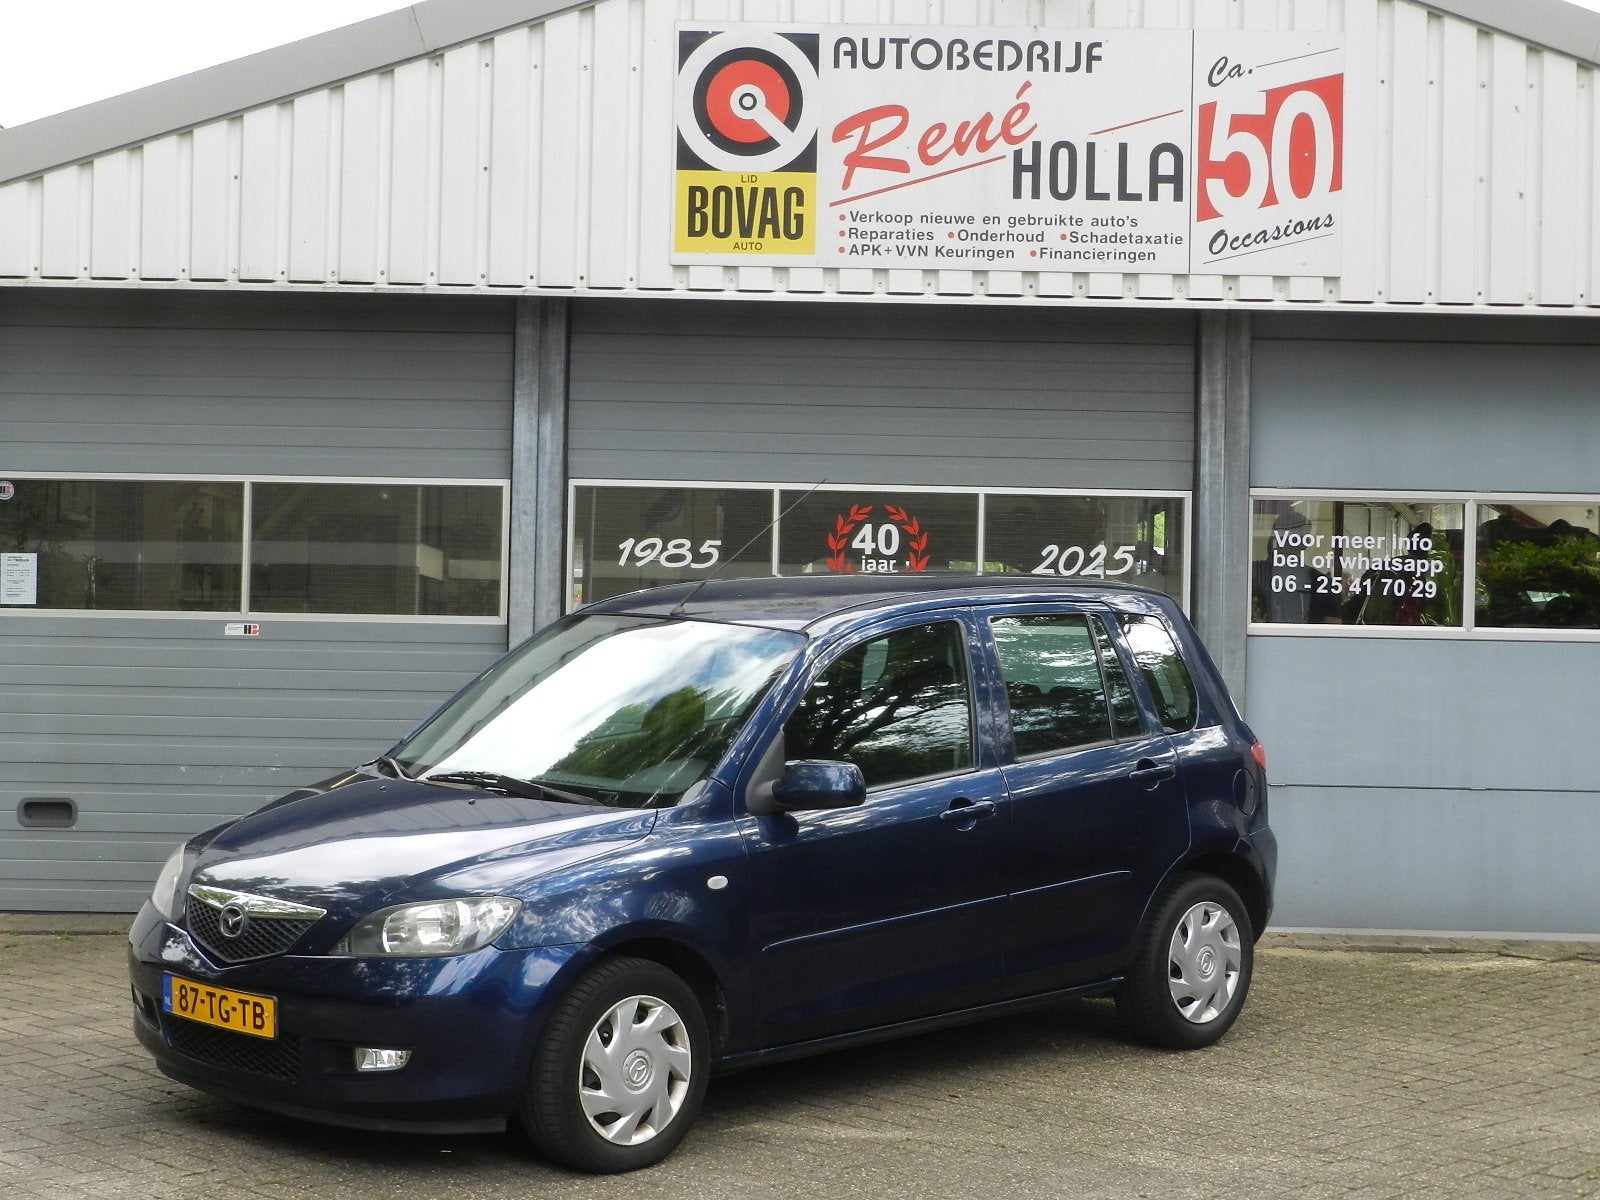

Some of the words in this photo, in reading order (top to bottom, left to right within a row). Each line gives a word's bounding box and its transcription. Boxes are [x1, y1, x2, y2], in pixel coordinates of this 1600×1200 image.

[833, 37, 1102, 73] AUTOBEDRIJF
[1207, 56, 1253, 87] Ca.
[832, 80, 1037, 190] René
[1012, 140, 1184, 202] HOLLA
[1205, 90, 1334, 220] 50
[741, 175, 757, 183] LID
[688, 185, 805, 240] BOVAG
[849, 211, 913, 225] Verkoop
[920, 212, 975, 225] nieuwe
[982, 215, 1001, 225] en
[1008, 214, 1084, 229] gebruikte
[1090, 215, 1138, 228] auto's
[733, 241, 763, 251] AUTO
[848, 227, 934, 241] Reparaties
[957, 229, 1045, 243] Onderhoud
[1069, 231, 1183, 246] Schadetaxatie
[1208, 213, 1335, 255] Occasions
[935, 245, 1015, 260] Keuringen
[1039, 247, 1156, 262] Financieringen
[618, 537, 722, 569] 1985
[852, 523, 900, 556] 40
[1274, 530, 1324, 548] Voor
[1331, 534, 1385, 549] meer
[1392, 533, 1432, 551] info
[1031, 544, 1136, 576] 2025
[1273, 550, 1305, 568] bel
[1312, 552, 1335, 568] of
[1340, 553, 1444, 577] whatsapp
[1271, 575, 1297, 593] 06
[1316, 576, 1343, 594] 25
[1349, 578, 1372, 596] 41
[1381, 579, 1406, 597] 70
[1411, 580, 1437, 598] 29
[179, 984, 265, 1030] 87-TG-TB
